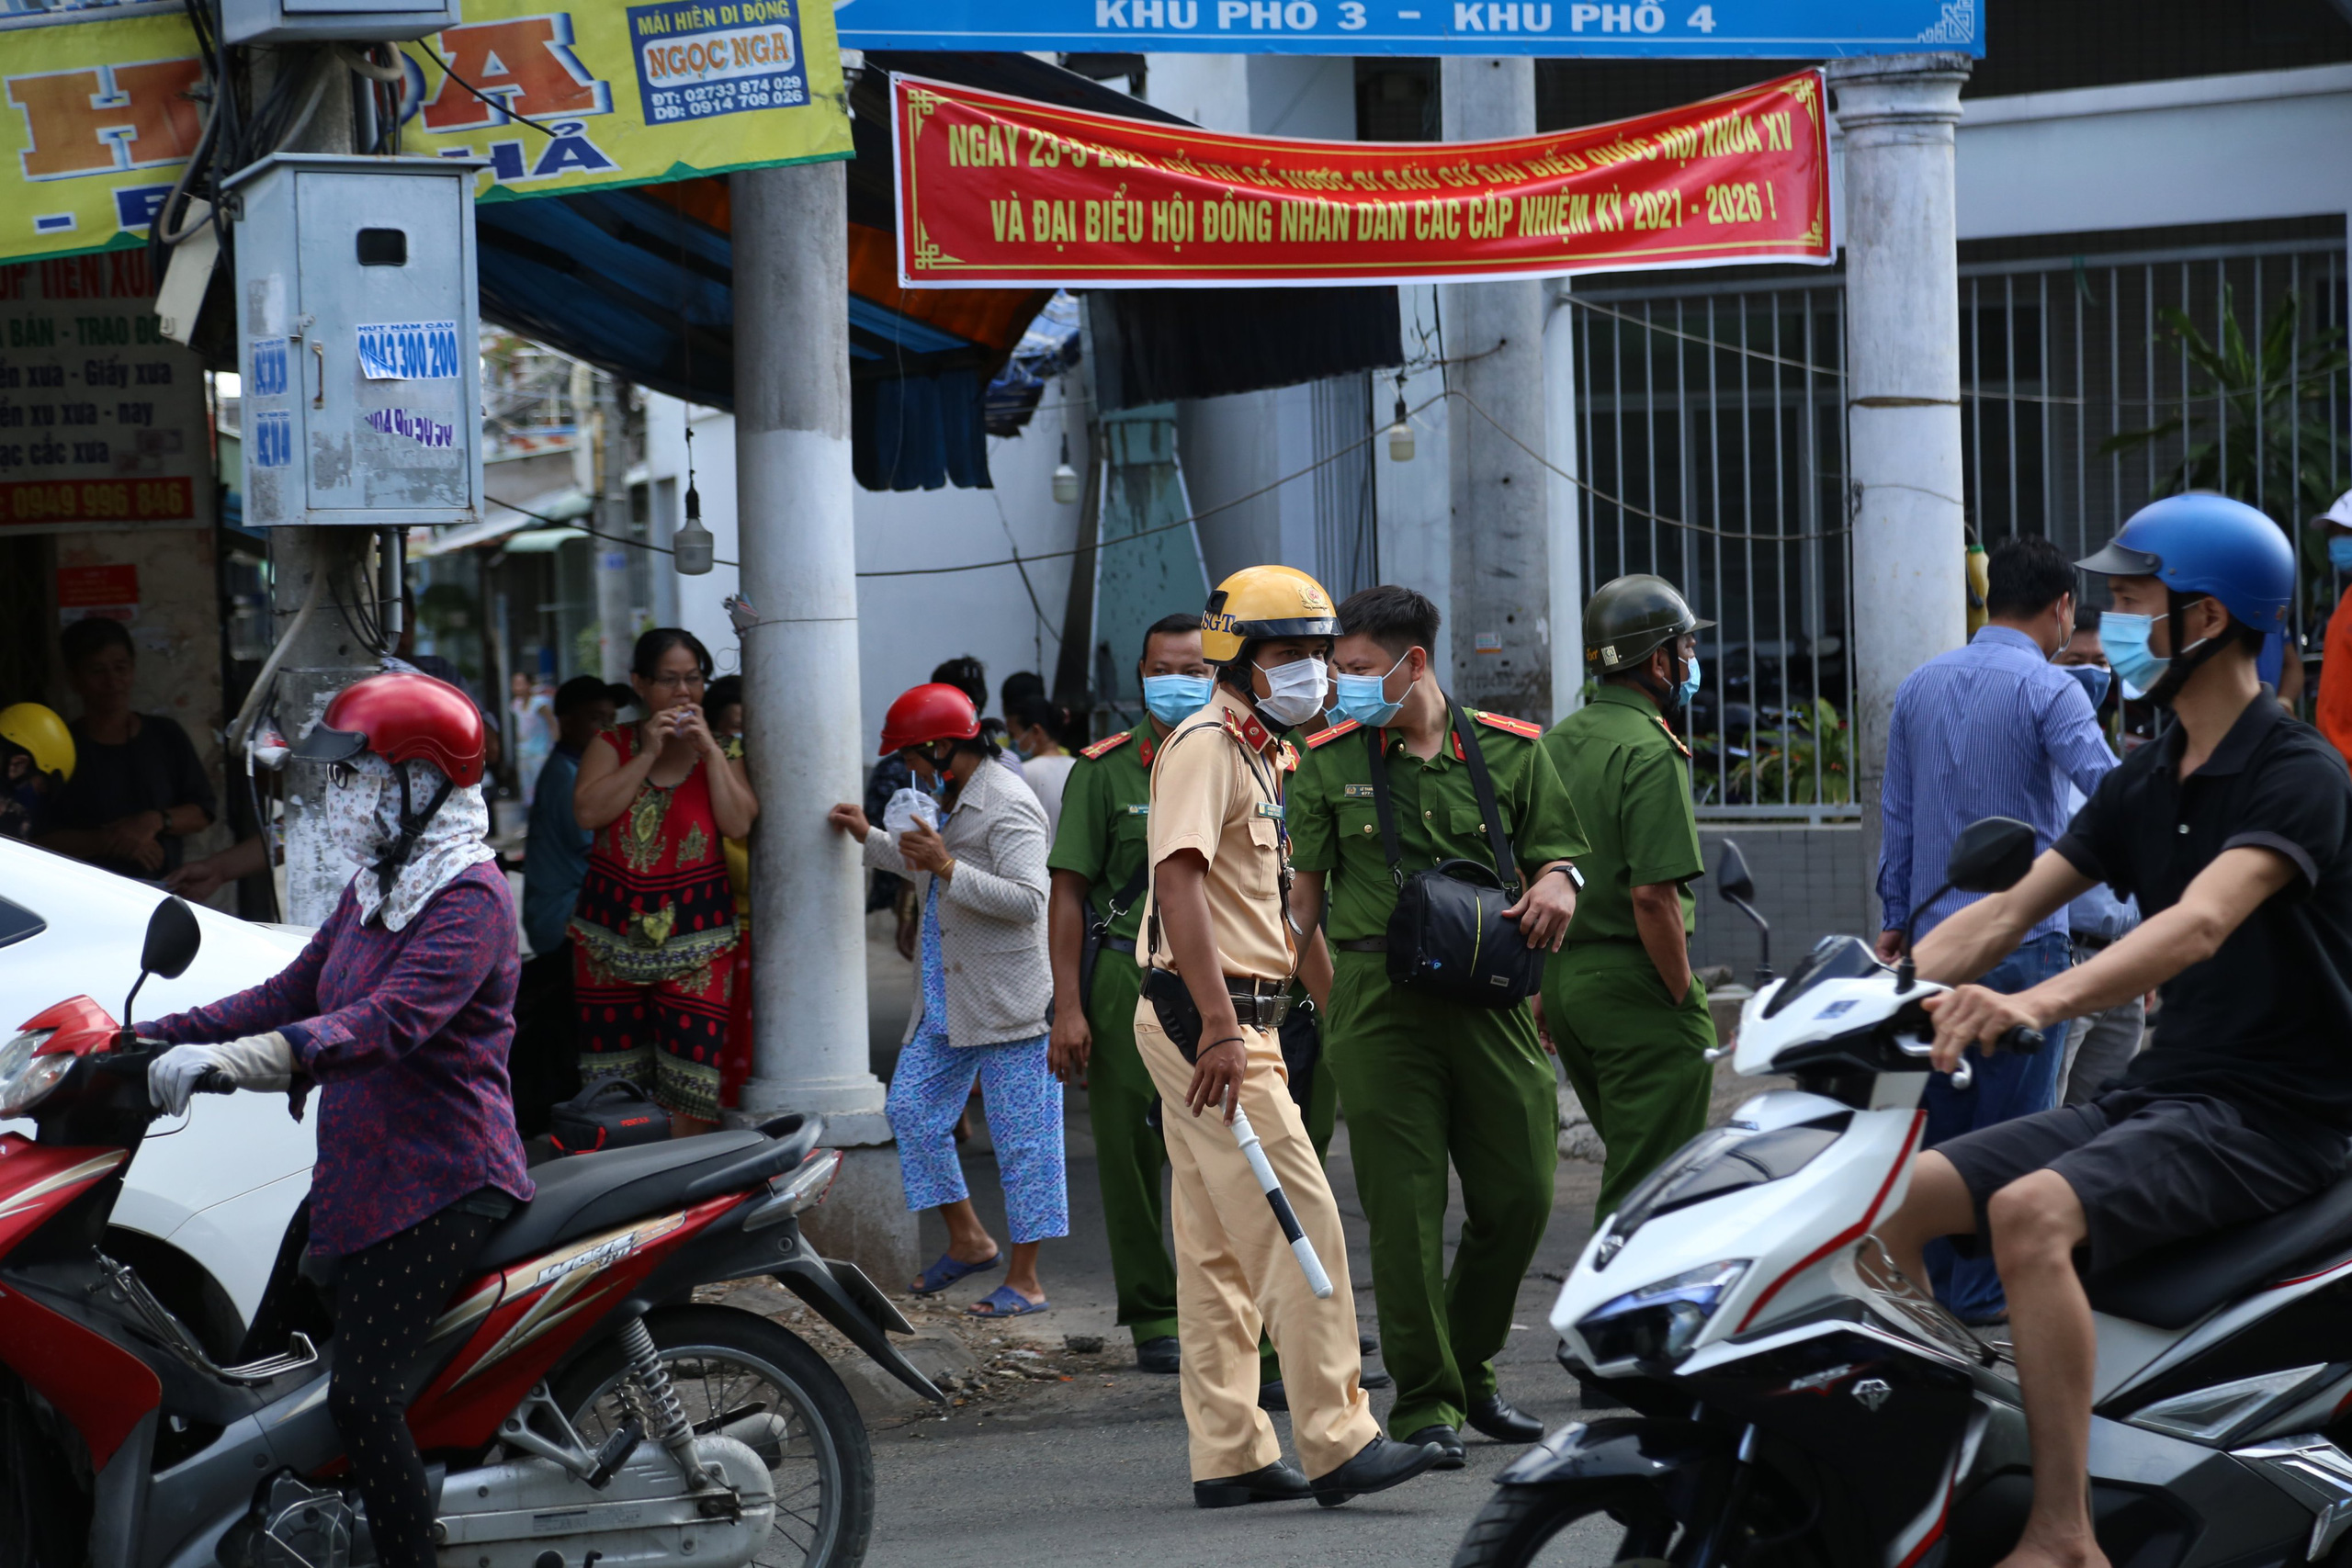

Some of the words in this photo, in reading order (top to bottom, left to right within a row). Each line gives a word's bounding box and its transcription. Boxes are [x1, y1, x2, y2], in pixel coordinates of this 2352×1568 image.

[637, 10, 671, 36] MÁI
[674, 5, 717, 31] HIÊN
[719, 5, 739, 25] DI
[1096, 0, 1198, 28] KHU
[1338, 2, 1367, 30] 3
[1454, 3, 1552, 32] KHU
[1687, 5, 1716, 33] 4
[647, 39, 729, 80] NGỌC
[730, 32, 793, 68] NGA
[740, 79, 770, 94] 874
[690, 98, 734, 116] 0914
[948, 117, 1021, 167] NGÀY
[1197, 162, 1246, 183] TRI
[1241, 159, 1285, 188] CẢ
[1475, 163, 1529, 185] ĐẠI
[1524, 144, 1589, 178] BIỂU
[1585, 132, 1657, 167] QUỐC
[1654, 125, 1698, 168] HỘI
[1700, 107, 1763, 158] KHÓA
[1760, 110, 1792, 152] XV
[990, 190, 1026, 243] VÀ
[1032, 199, 1077, 253] ĐẠI
[1084, 183, 1144, 243] BIỂU
[1151, 190, 1194, 253] HỘI
[1202, 186, 1272, 243] ĐỒNG
[1281, 196, 1350, 243] NHÂN
[1357, 196, 1408, 243] DÂN
[1414, 193, 1462, 241] CÁC
[1468, 187, 1514, 240] CẤP
[1518, 187, 1592, 245] NHIỆM
[1629, 186, 1683, 231] 2021
[1704, 183, 1763, 226] 2026
[1200, 610, 1236, 633] SGT
